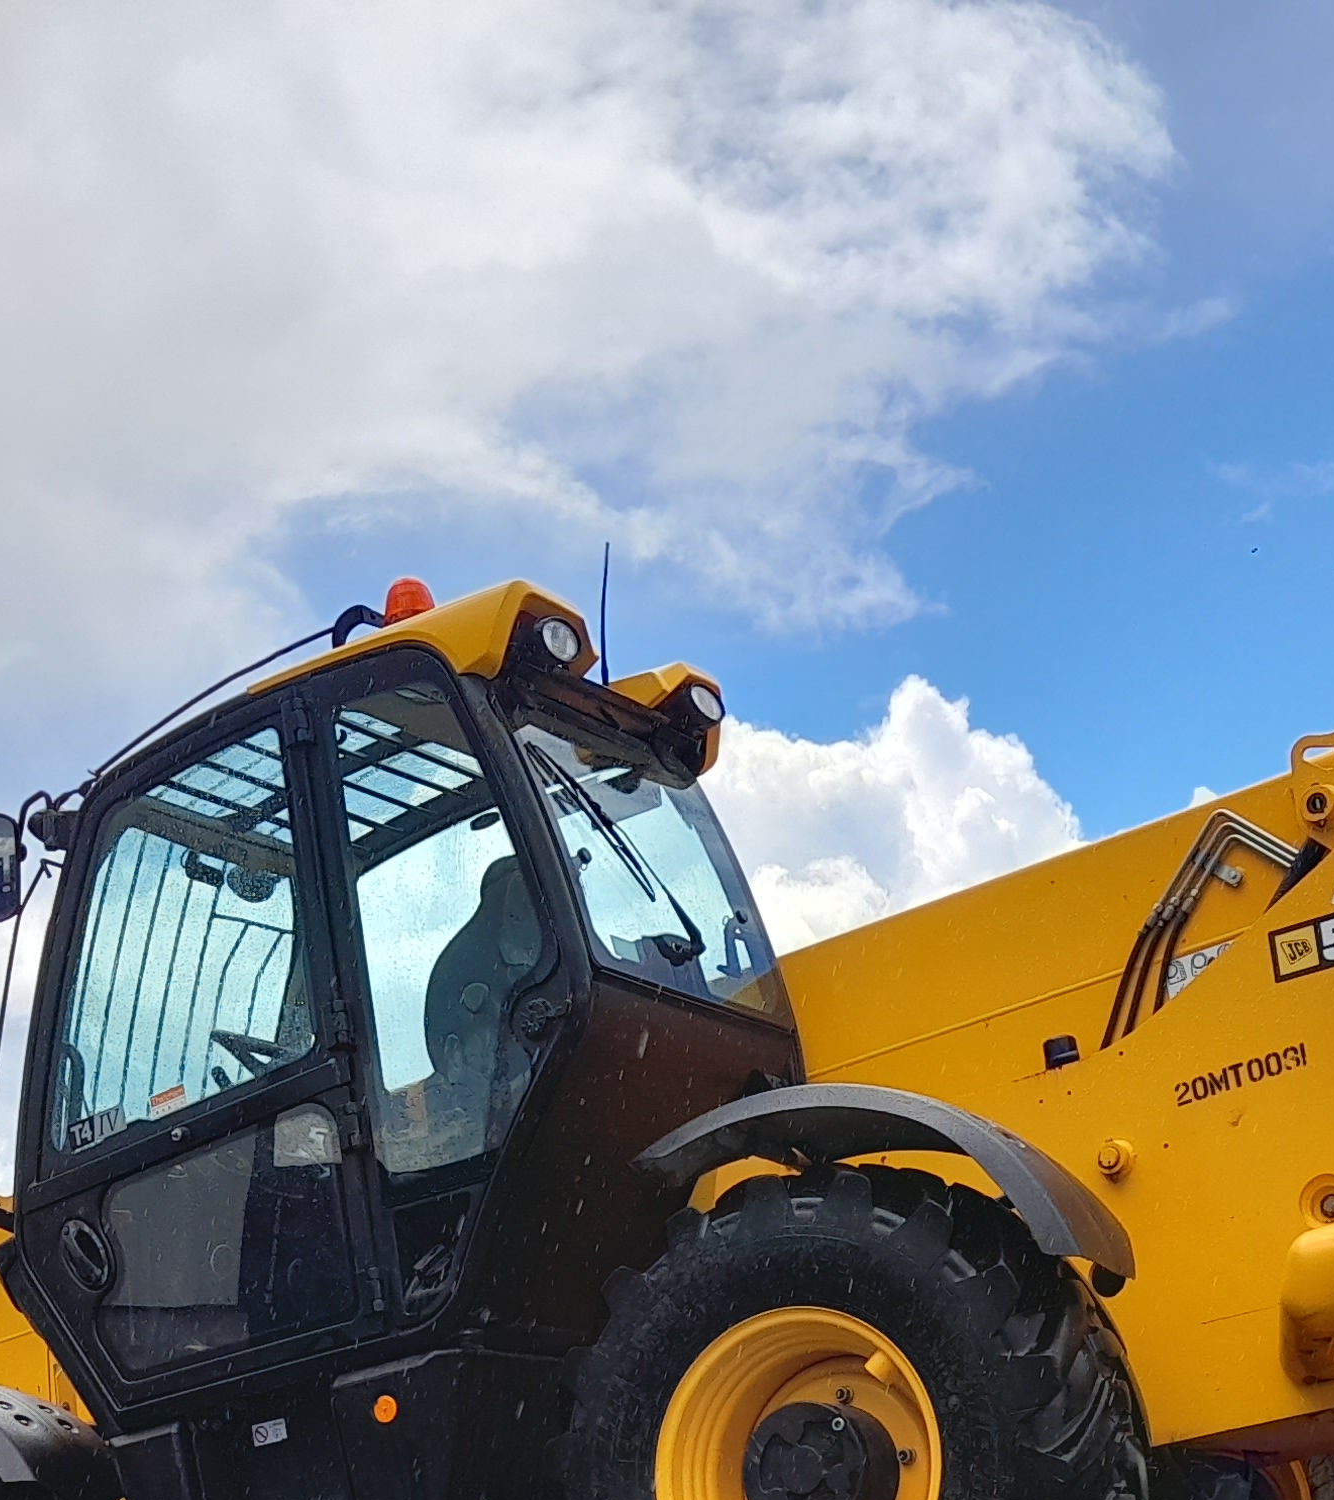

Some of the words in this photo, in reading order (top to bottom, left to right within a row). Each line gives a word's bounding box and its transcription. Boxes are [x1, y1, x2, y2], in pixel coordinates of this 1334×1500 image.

[1286, 941, 1312, 963] JCB
[69, 1120, 93, 1146] T4
[99, 1108, 120, 1136] IV
